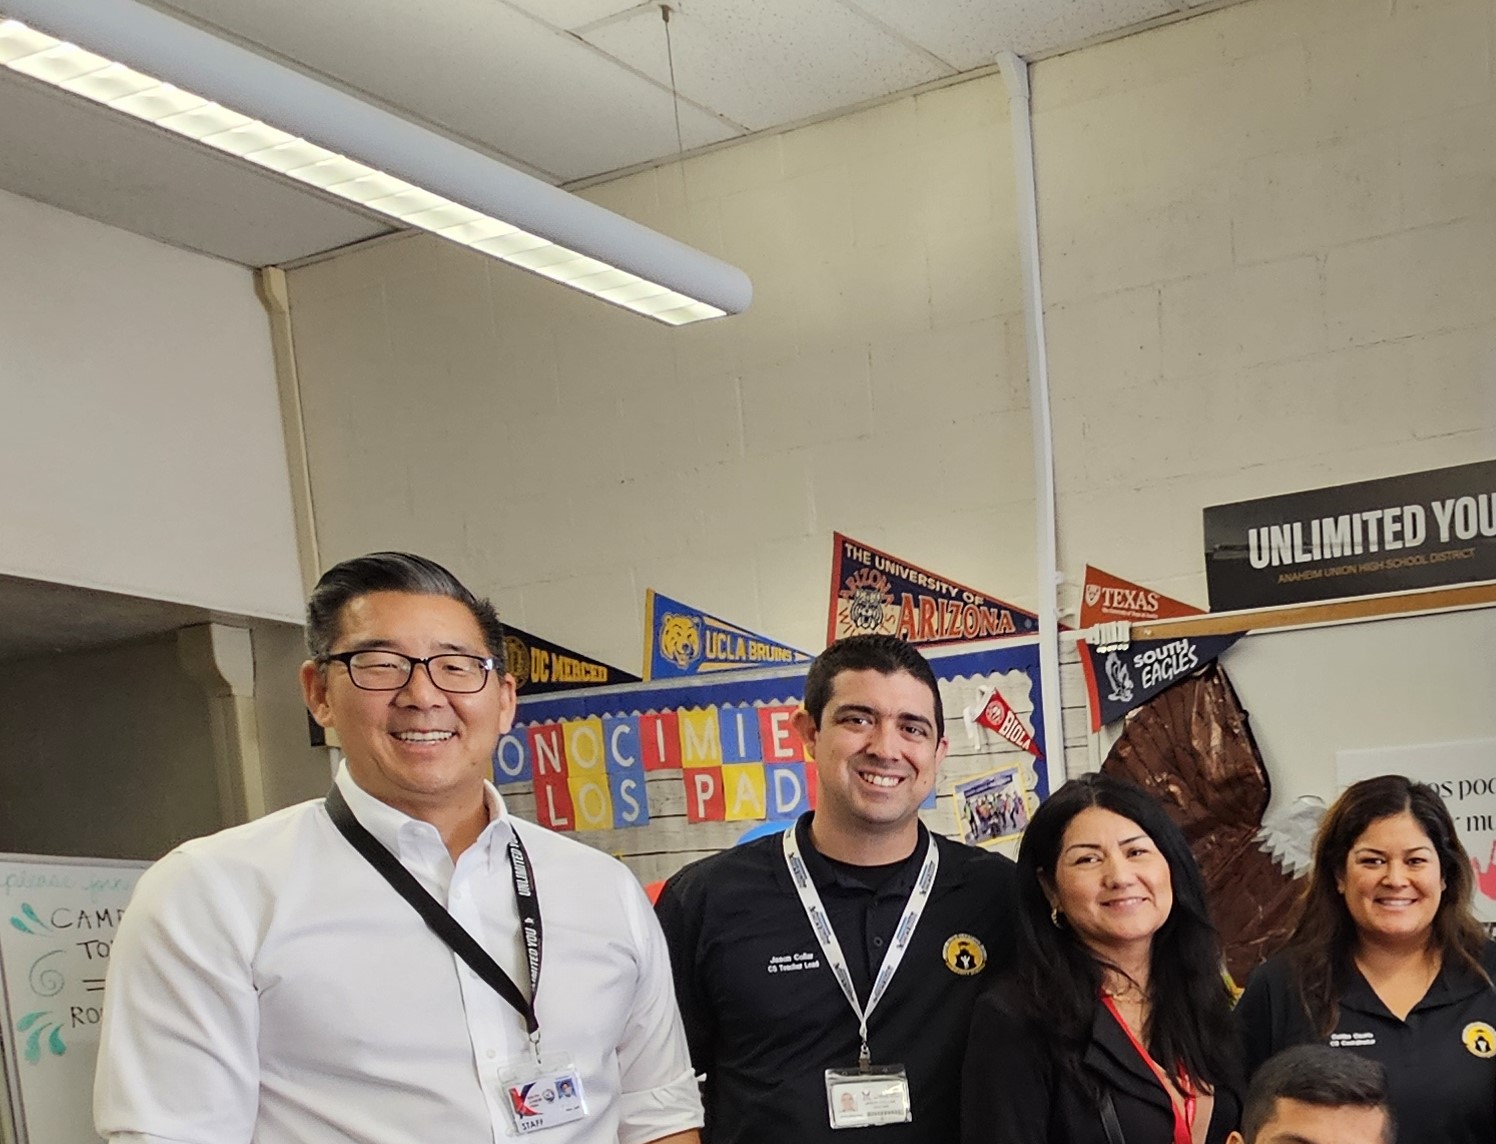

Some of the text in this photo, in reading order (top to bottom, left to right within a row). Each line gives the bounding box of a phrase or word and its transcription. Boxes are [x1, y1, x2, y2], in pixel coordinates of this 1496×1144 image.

[1248, 504, 1427, 569] UNLIMITED
[845, 543, 984, 604] THE UNIVERSITY OF
[1278, 548, 1476, 583] ANAHEIM UNION HIGH SCHOOL DISTRICT
[896, 592, 1016, 641] ARIZONA
[1101, 587, 1160, 612] TEXAS
[530, 647, 608, 683] UC MERCED
[705, 631, 793, 662] UCLA BRUINS
[1133, 639, 1189, 668] SOUTH
[1142, 644, 1199, 689] EAGLES
[497, 711, 794, 776] ONOCIMIE
[999, 711, 1031, 750] BIOLA
[545, 778, 640, 827] LOS
[693, 768, 802, 819] PAD
[510, 847, 531, 897] UNLIMITED
[76, 939, 113, 959] TO
[524, 926, 538, 947] YOU
[70, 1006, 103, 1028] RO
